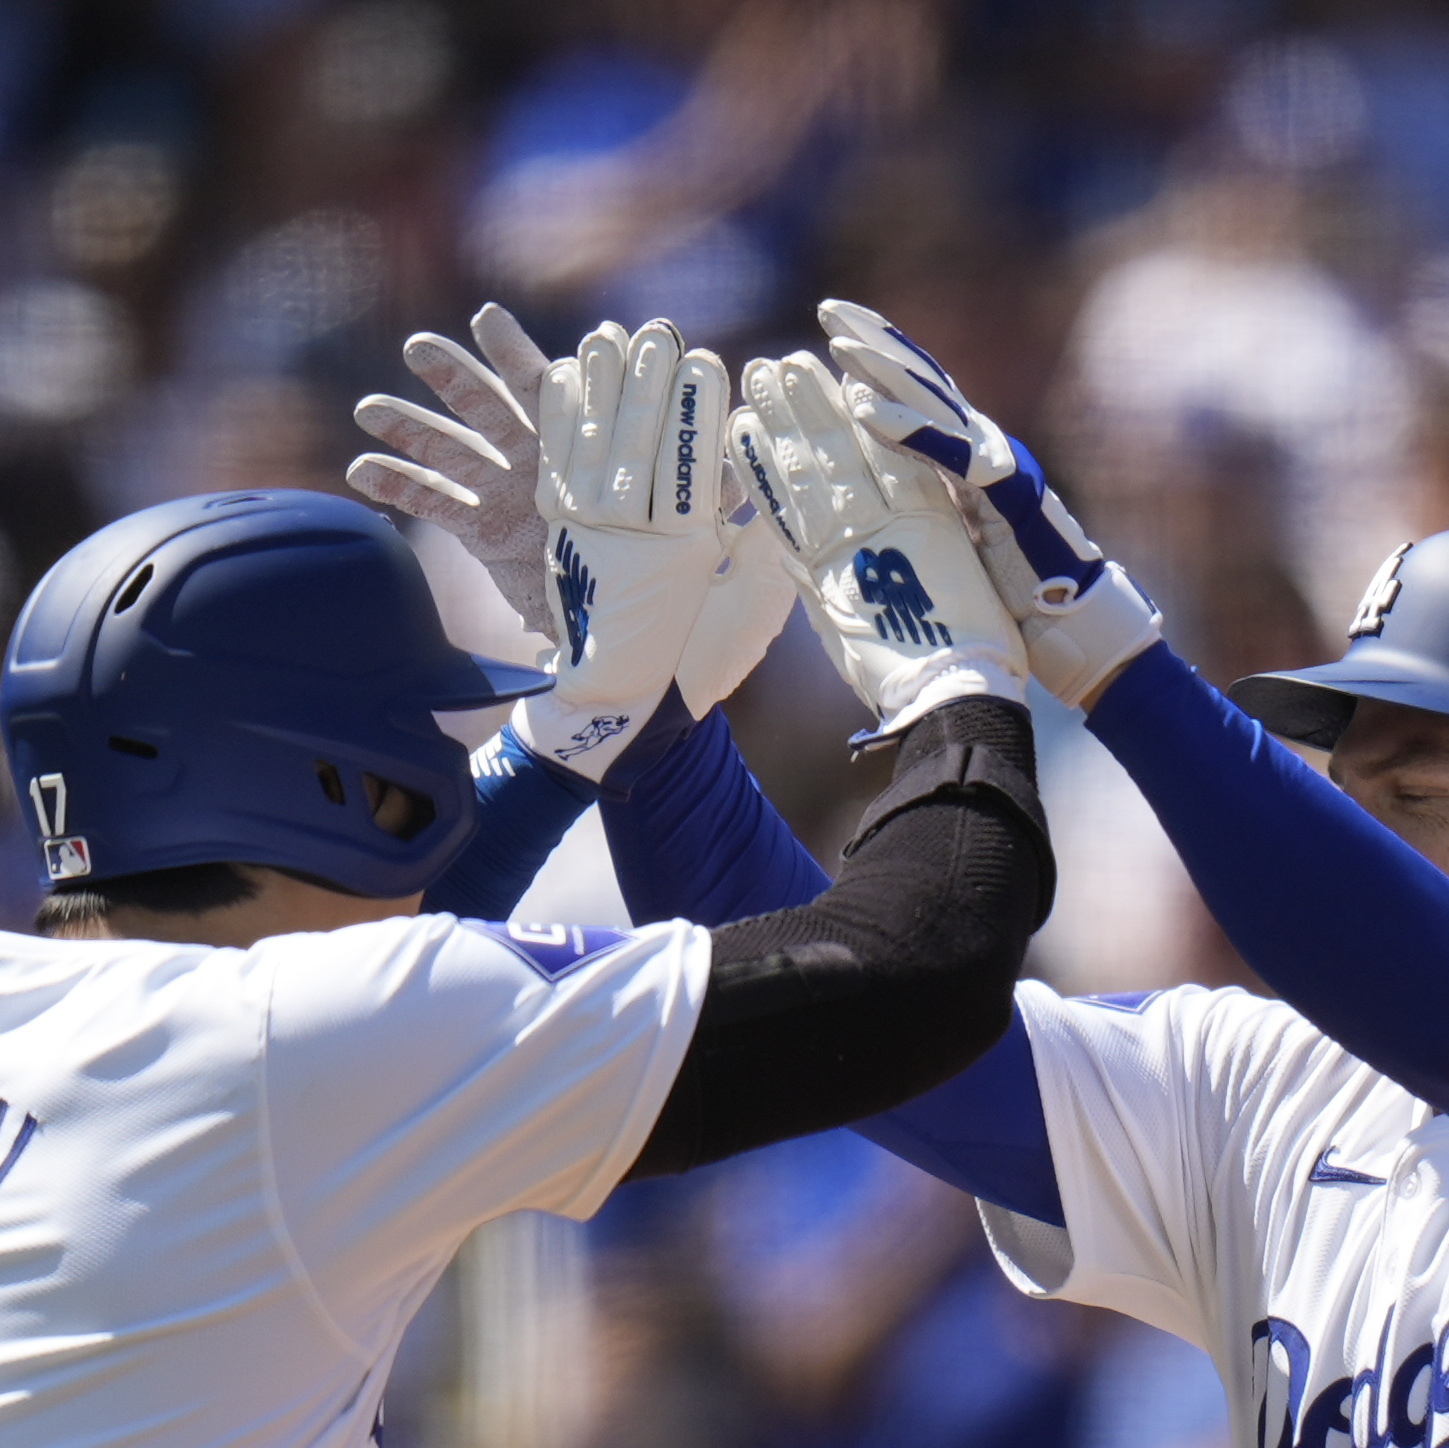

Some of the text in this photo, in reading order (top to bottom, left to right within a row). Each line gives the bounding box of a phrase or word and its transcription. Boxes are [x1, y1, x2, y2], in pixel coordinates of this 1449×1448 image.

[675, 383, 698, 515] new balance
[29, 772, 67, 837] 17
